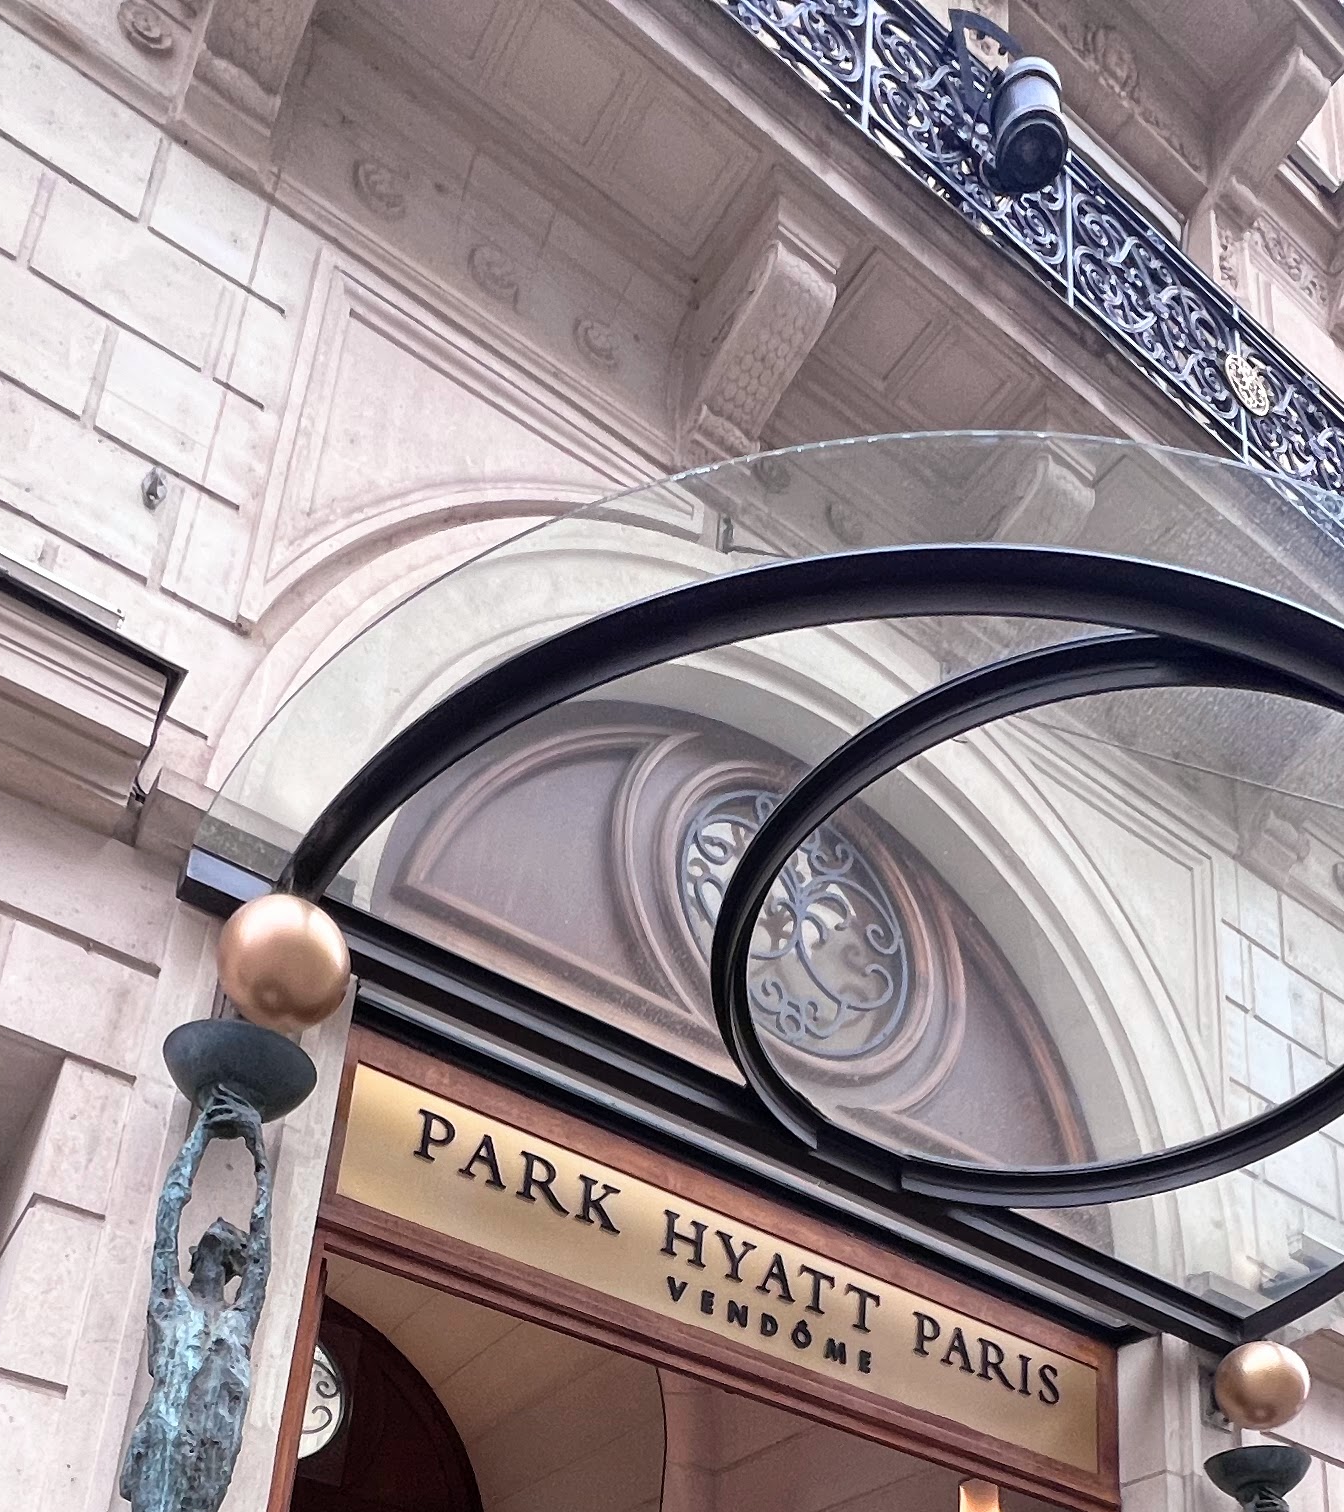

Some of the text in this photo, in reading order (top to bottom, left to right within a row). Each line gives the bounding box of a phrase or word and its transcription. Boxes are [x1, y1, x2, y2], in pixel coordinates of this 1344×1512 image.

[413, 1108, 1063, 1405] PARK HYATT PARIS
[666, 1276, 873, 1375] VENDÔME
